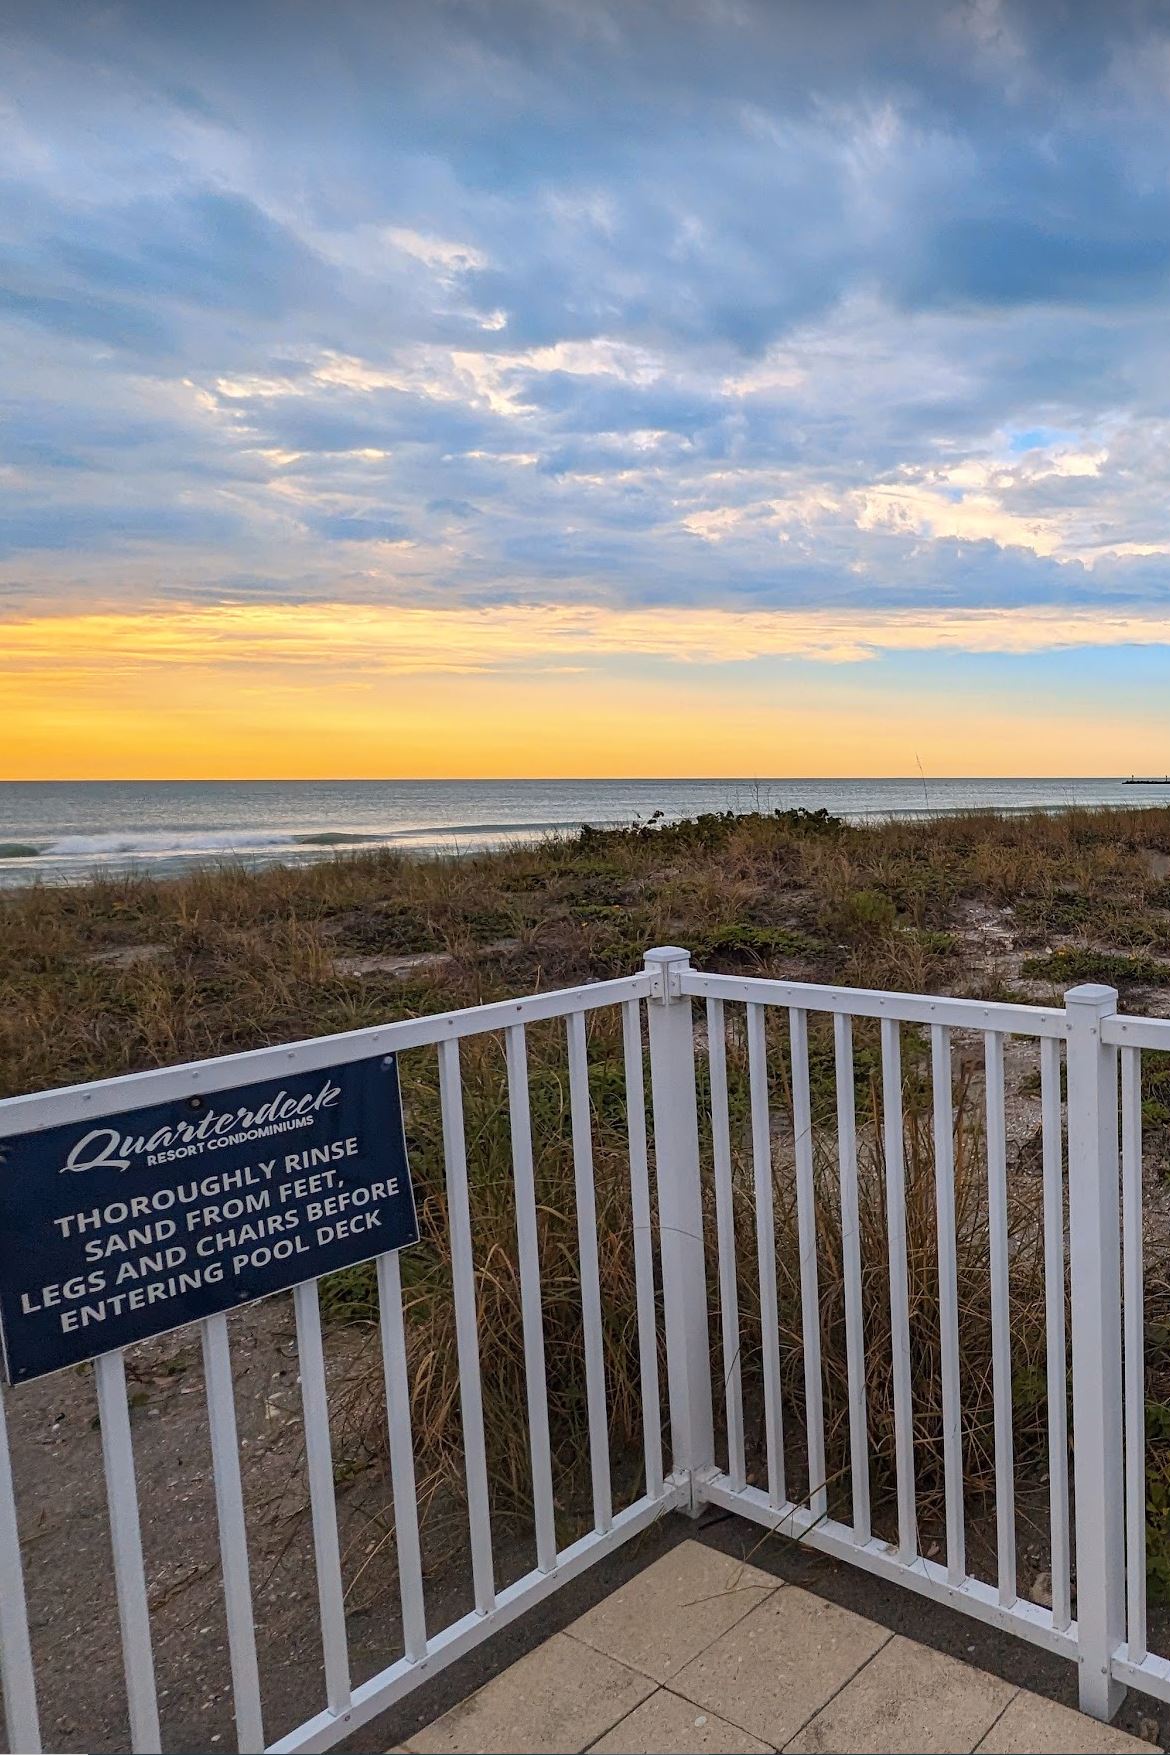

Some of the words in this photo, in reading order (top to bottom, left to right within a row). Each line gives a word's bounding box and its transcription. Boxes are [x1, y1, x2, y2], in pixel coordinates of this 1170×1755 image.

[60, 1080, 341, 1173] Quarterdeck
[147, 1142, 205, 1167] RESORT
[207, 1115, 314, 1150] CONDOMINIUMS
[54, 1160, 275, 1237] THOROUGHLY
[285, 1137, 358, 1173] RINSE
[85, 1220, 176, 1262] SAND
[186, 1191, 270, 1231] FROM
[280, 1169, 343, 1202] FEET,
[22, 1271, 105, 1314] LEGS
[116, 1247, 186, 1284] AND
[197, 1210, 299, 1256] CHAIRS
[307, 1178, 399, 1221] BEFORE
[61, 1263, 223, 1332] ENTERING
[233, 1236, 309, 1274] POOL
[317, 1209, 381, 1245] DECK
